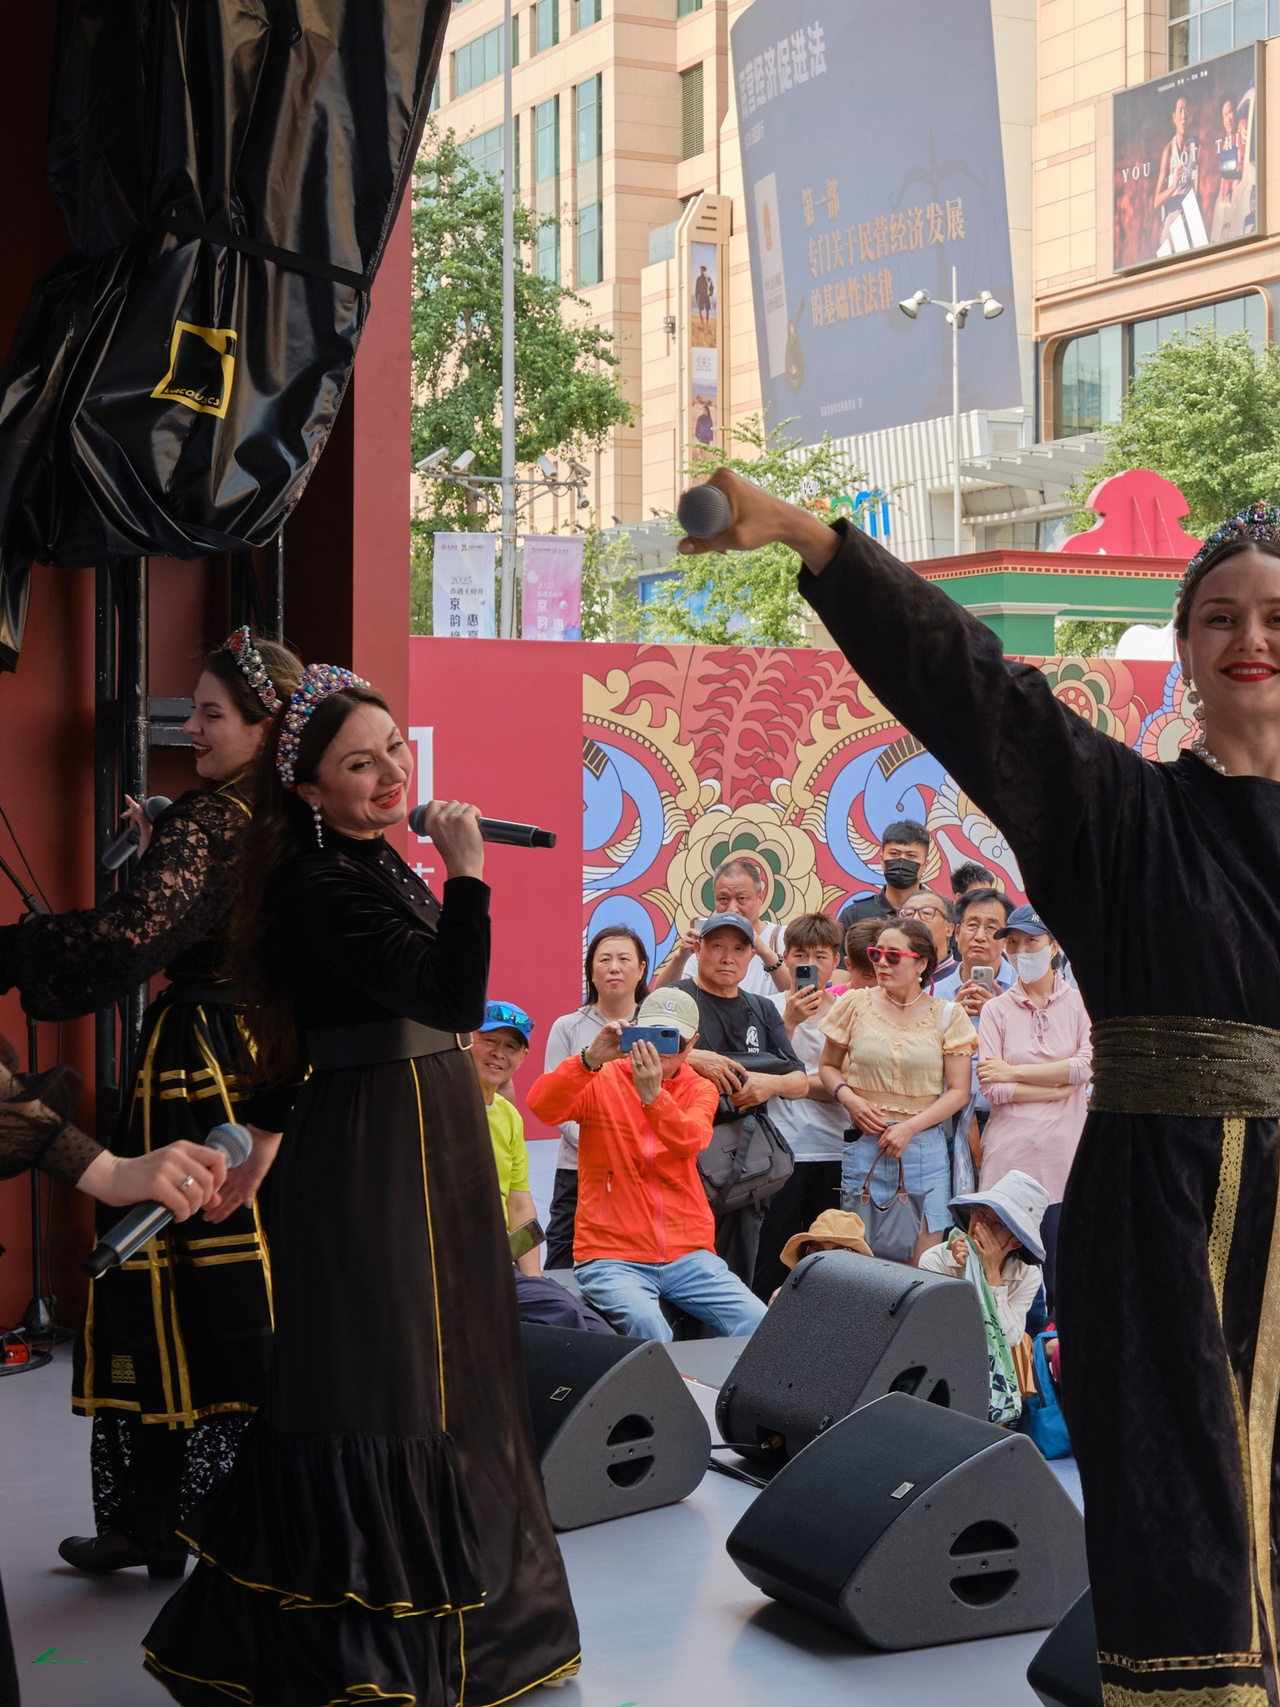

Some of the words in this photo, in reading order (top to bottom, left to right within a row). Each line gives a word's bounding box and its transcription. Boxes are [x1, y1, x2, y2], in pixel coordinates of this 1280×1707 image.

[739, 21, 828, 121] 民营经济促进法
[1122, 162, 1150, 183] YOU
[1171, 147, 1198, 168] GOT
[1215, 129, 1248, 154] THIS
[802, 179, 840, 228] 第一部
[807, 196, 966, 278] 专门关于民营经济发展
[811, 268, 894, 329] 的基础性法律
[450, 576, 473, 585] 2025
